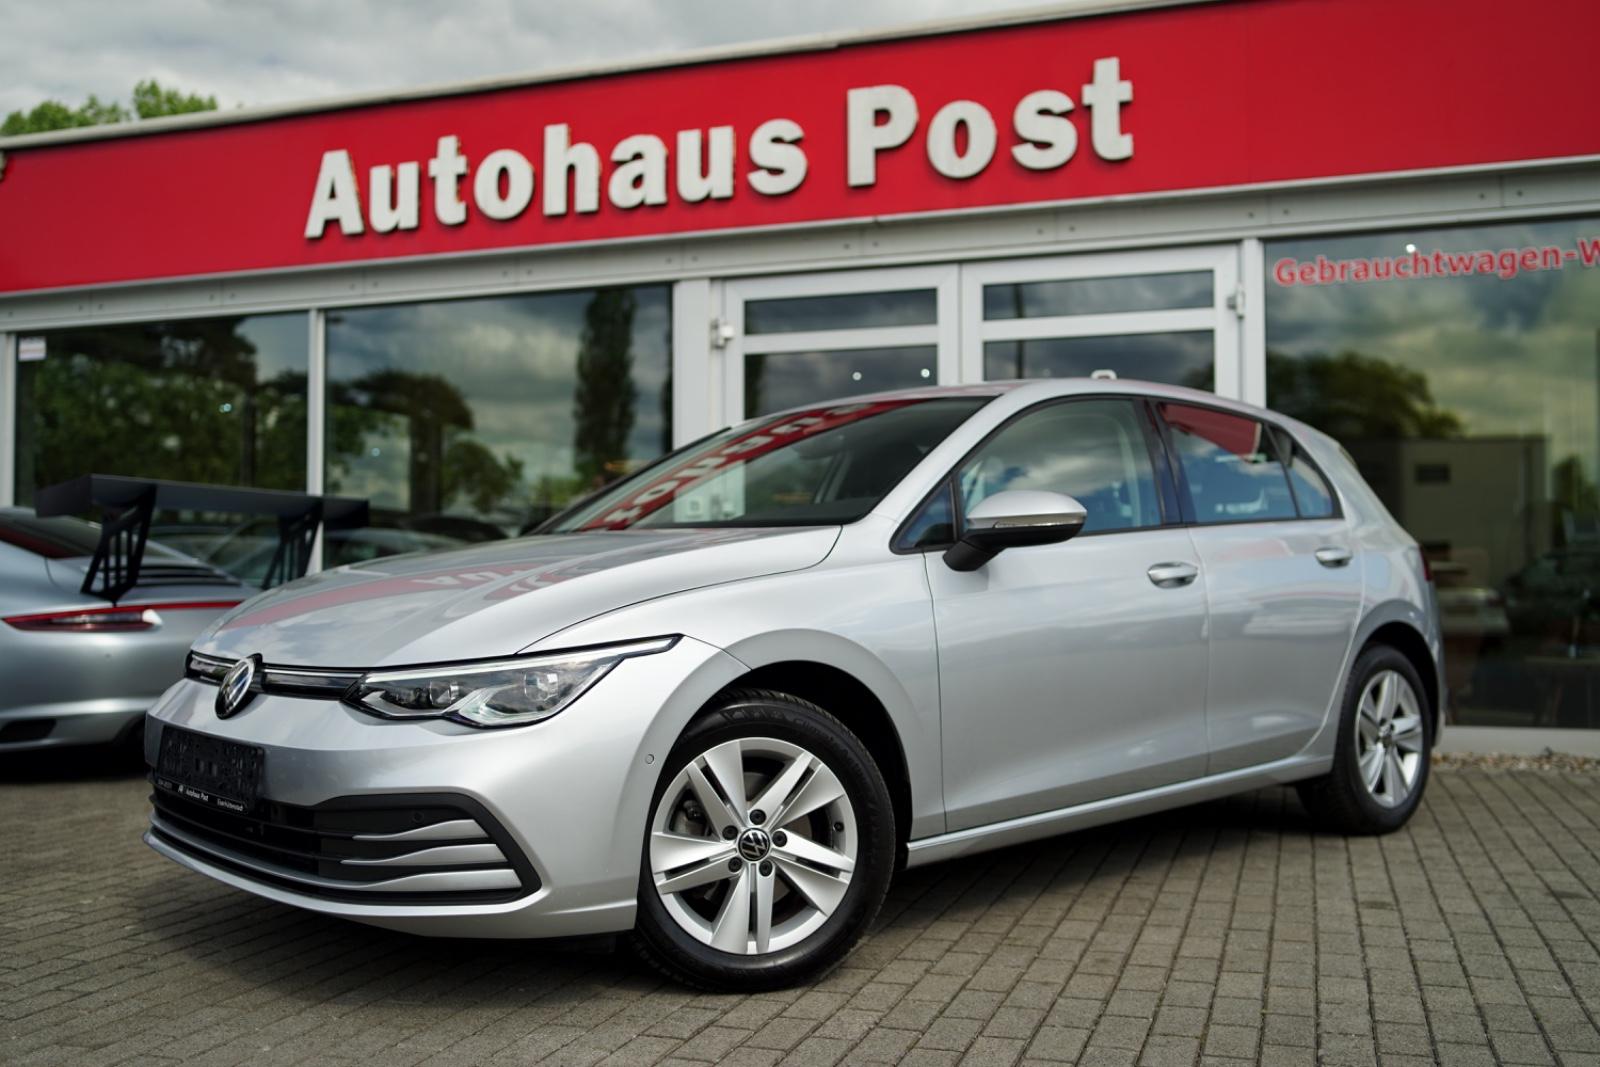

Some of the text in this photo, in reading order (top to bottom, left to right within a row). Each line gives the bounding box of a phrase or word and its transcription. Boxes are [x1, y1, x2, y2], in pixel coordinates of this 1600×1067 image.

[305, 57, 1134, 238] Autohaus Post
[739, 829, 769, 860] VW
